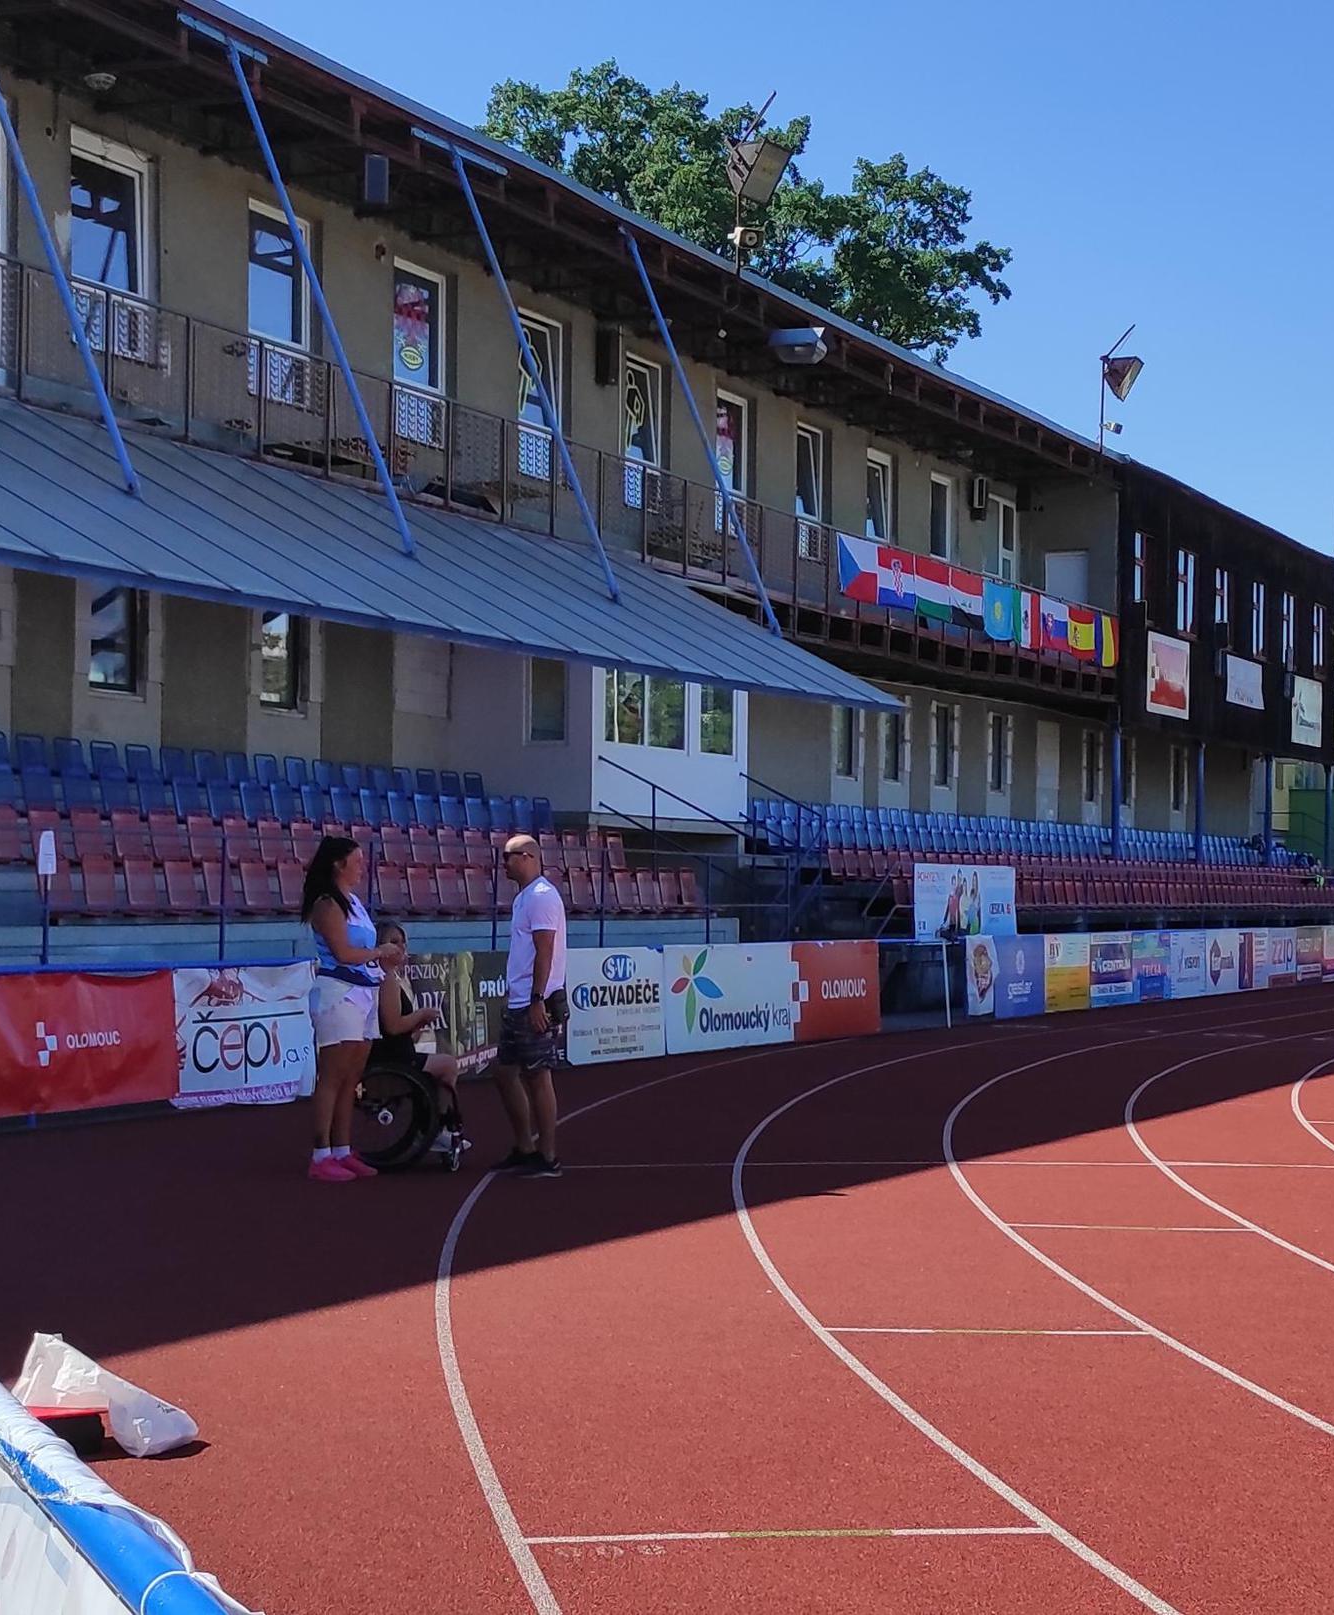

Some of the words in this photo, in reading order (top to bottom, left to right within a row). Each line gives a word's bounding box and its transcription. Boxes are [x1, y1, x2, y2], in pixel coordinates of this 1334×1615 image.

[581, 979, 660, 1008] ROZVADĚČE
[821, 978, 867, 1000] OLOMOUC
[699, 1002, 770, 1034] Olomoucký
[772, 1003, 791, 1031] kraj
[66, 1030, 121, 1049] OLOMOUC
